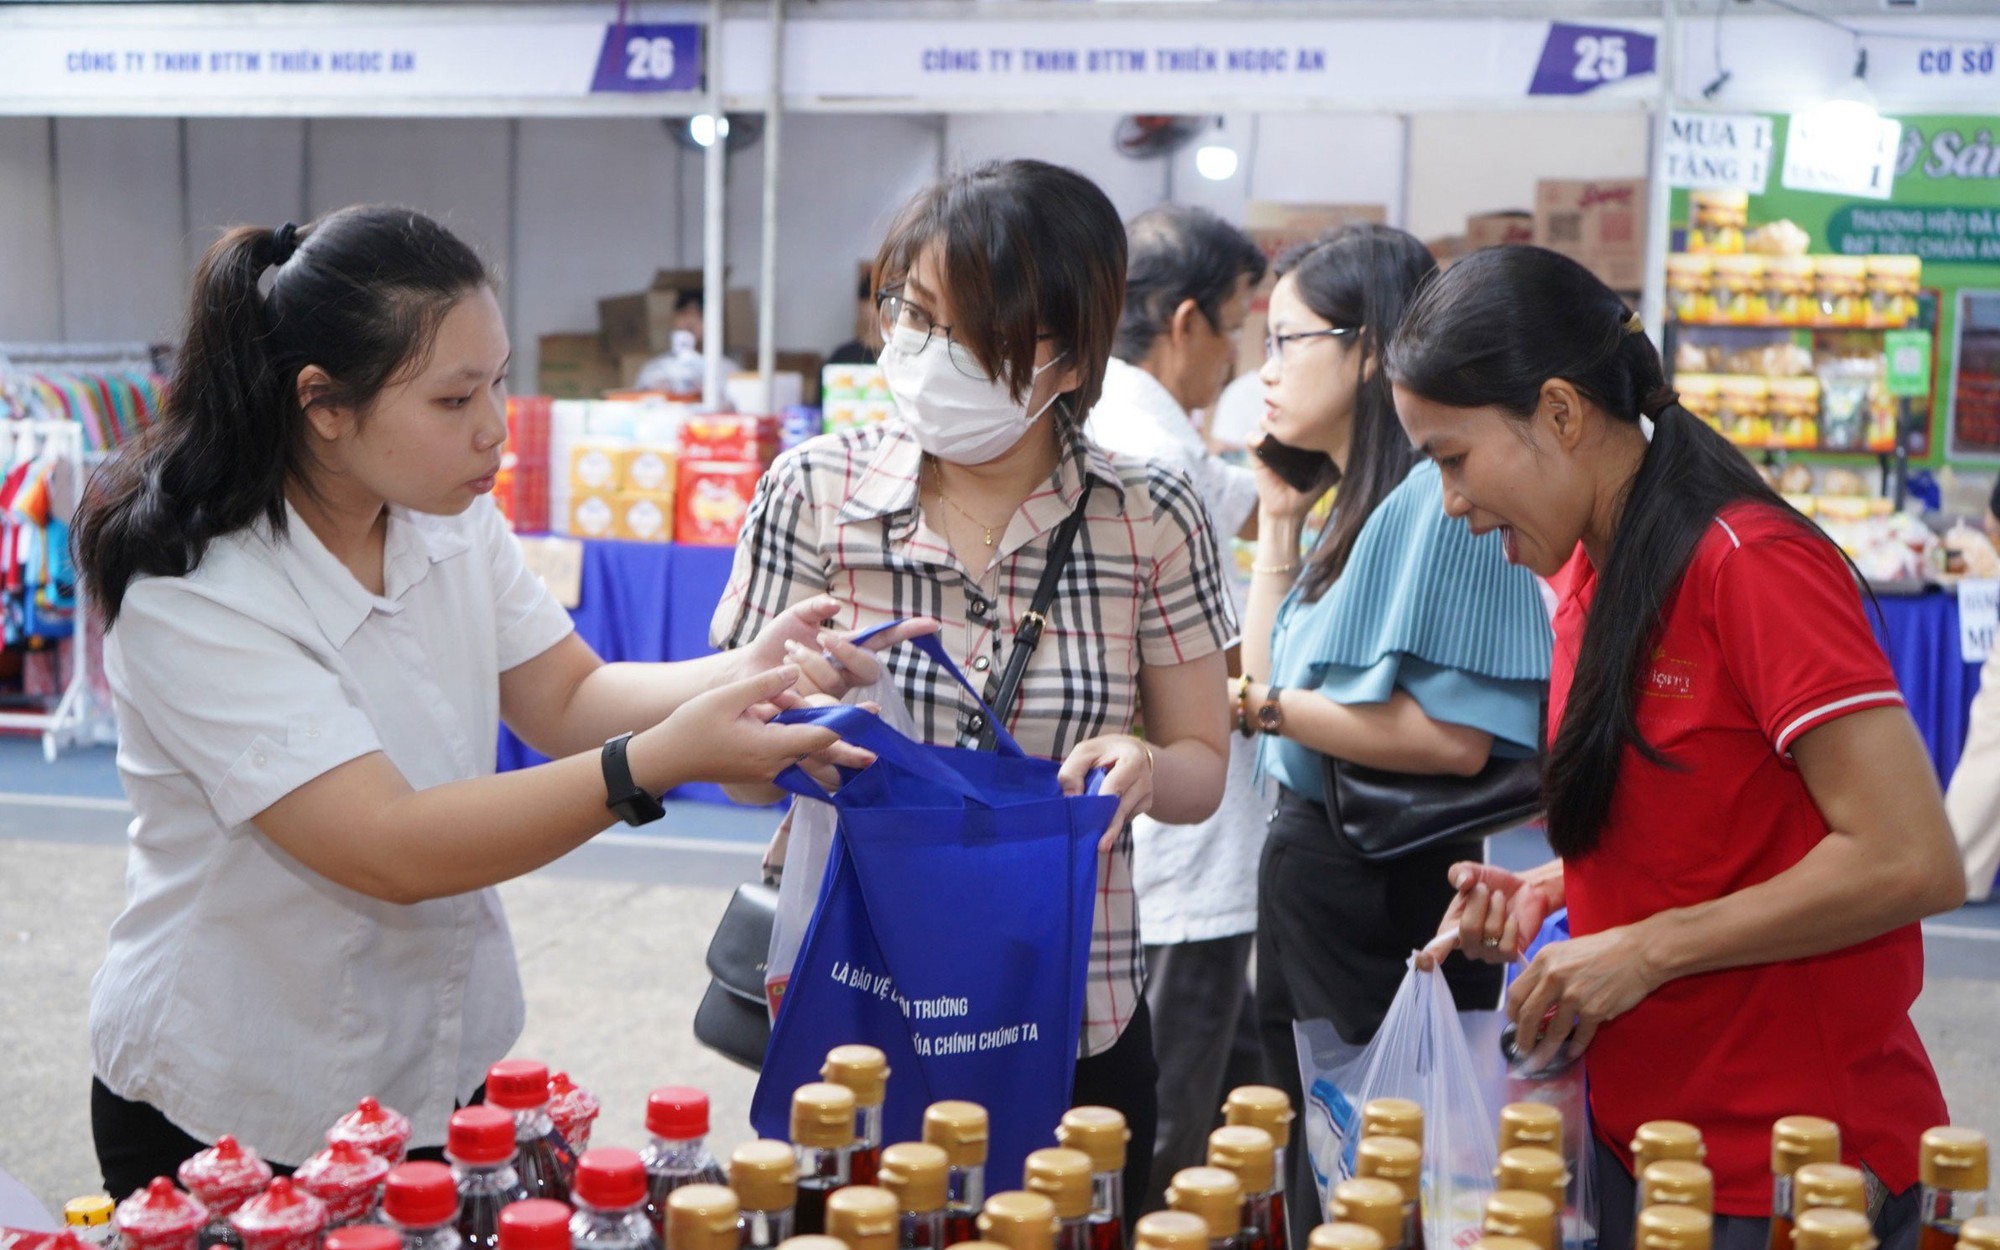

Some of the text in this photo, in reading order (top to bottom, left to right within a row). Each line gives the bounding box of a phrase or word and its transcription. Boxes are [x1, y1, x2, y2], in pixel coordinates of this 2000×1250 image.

[125, 51, 145, 73] TY
[626, 36, 676, 80] 26
[922, 45, 980, 73] CÔNG
[989, 50, 1011, 73] TY
[1022, 50, 1078, 73] TNHH
[1297, 49, 1325, 73] AN
[1574, 35, 1627, 81] 25
[1667, 119, 1736, 147] MUA
[831, 961, 850, 984] LÀ
[849, 966, 872, 992] BẢO
[872, 976, 892, 1000] VỆ
[913, 996, 969, 1020] TRƯỜNG
[912, 1022, 1039, 1057] ỦA CHÍNH CHÚNG TA
